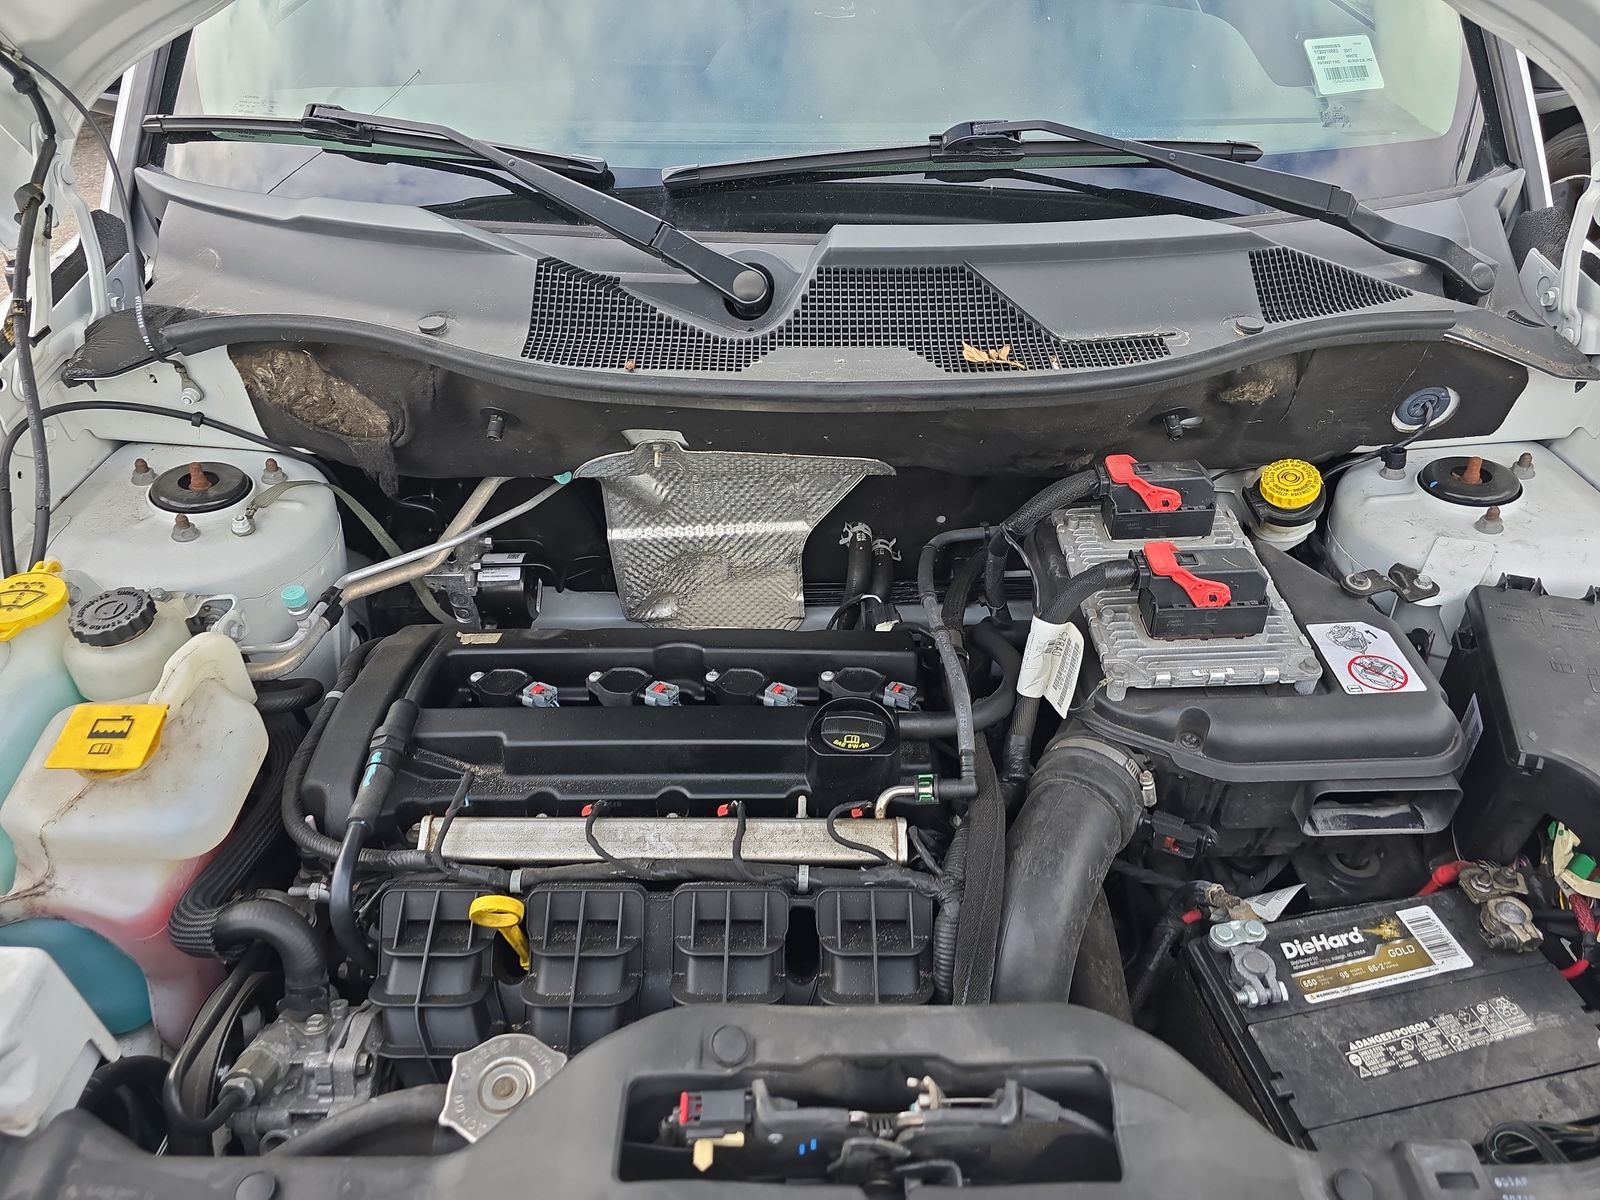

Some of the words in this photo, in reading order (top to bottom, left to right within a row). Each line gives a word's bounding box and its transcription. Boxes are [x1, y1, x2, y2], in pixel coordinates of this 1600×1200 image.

[1280, 926, 1365, 959] DieHard
[1387, 944, 1416, 958] GOLD
[1355, 1021, 1431, 1050] DANGER/POISON
